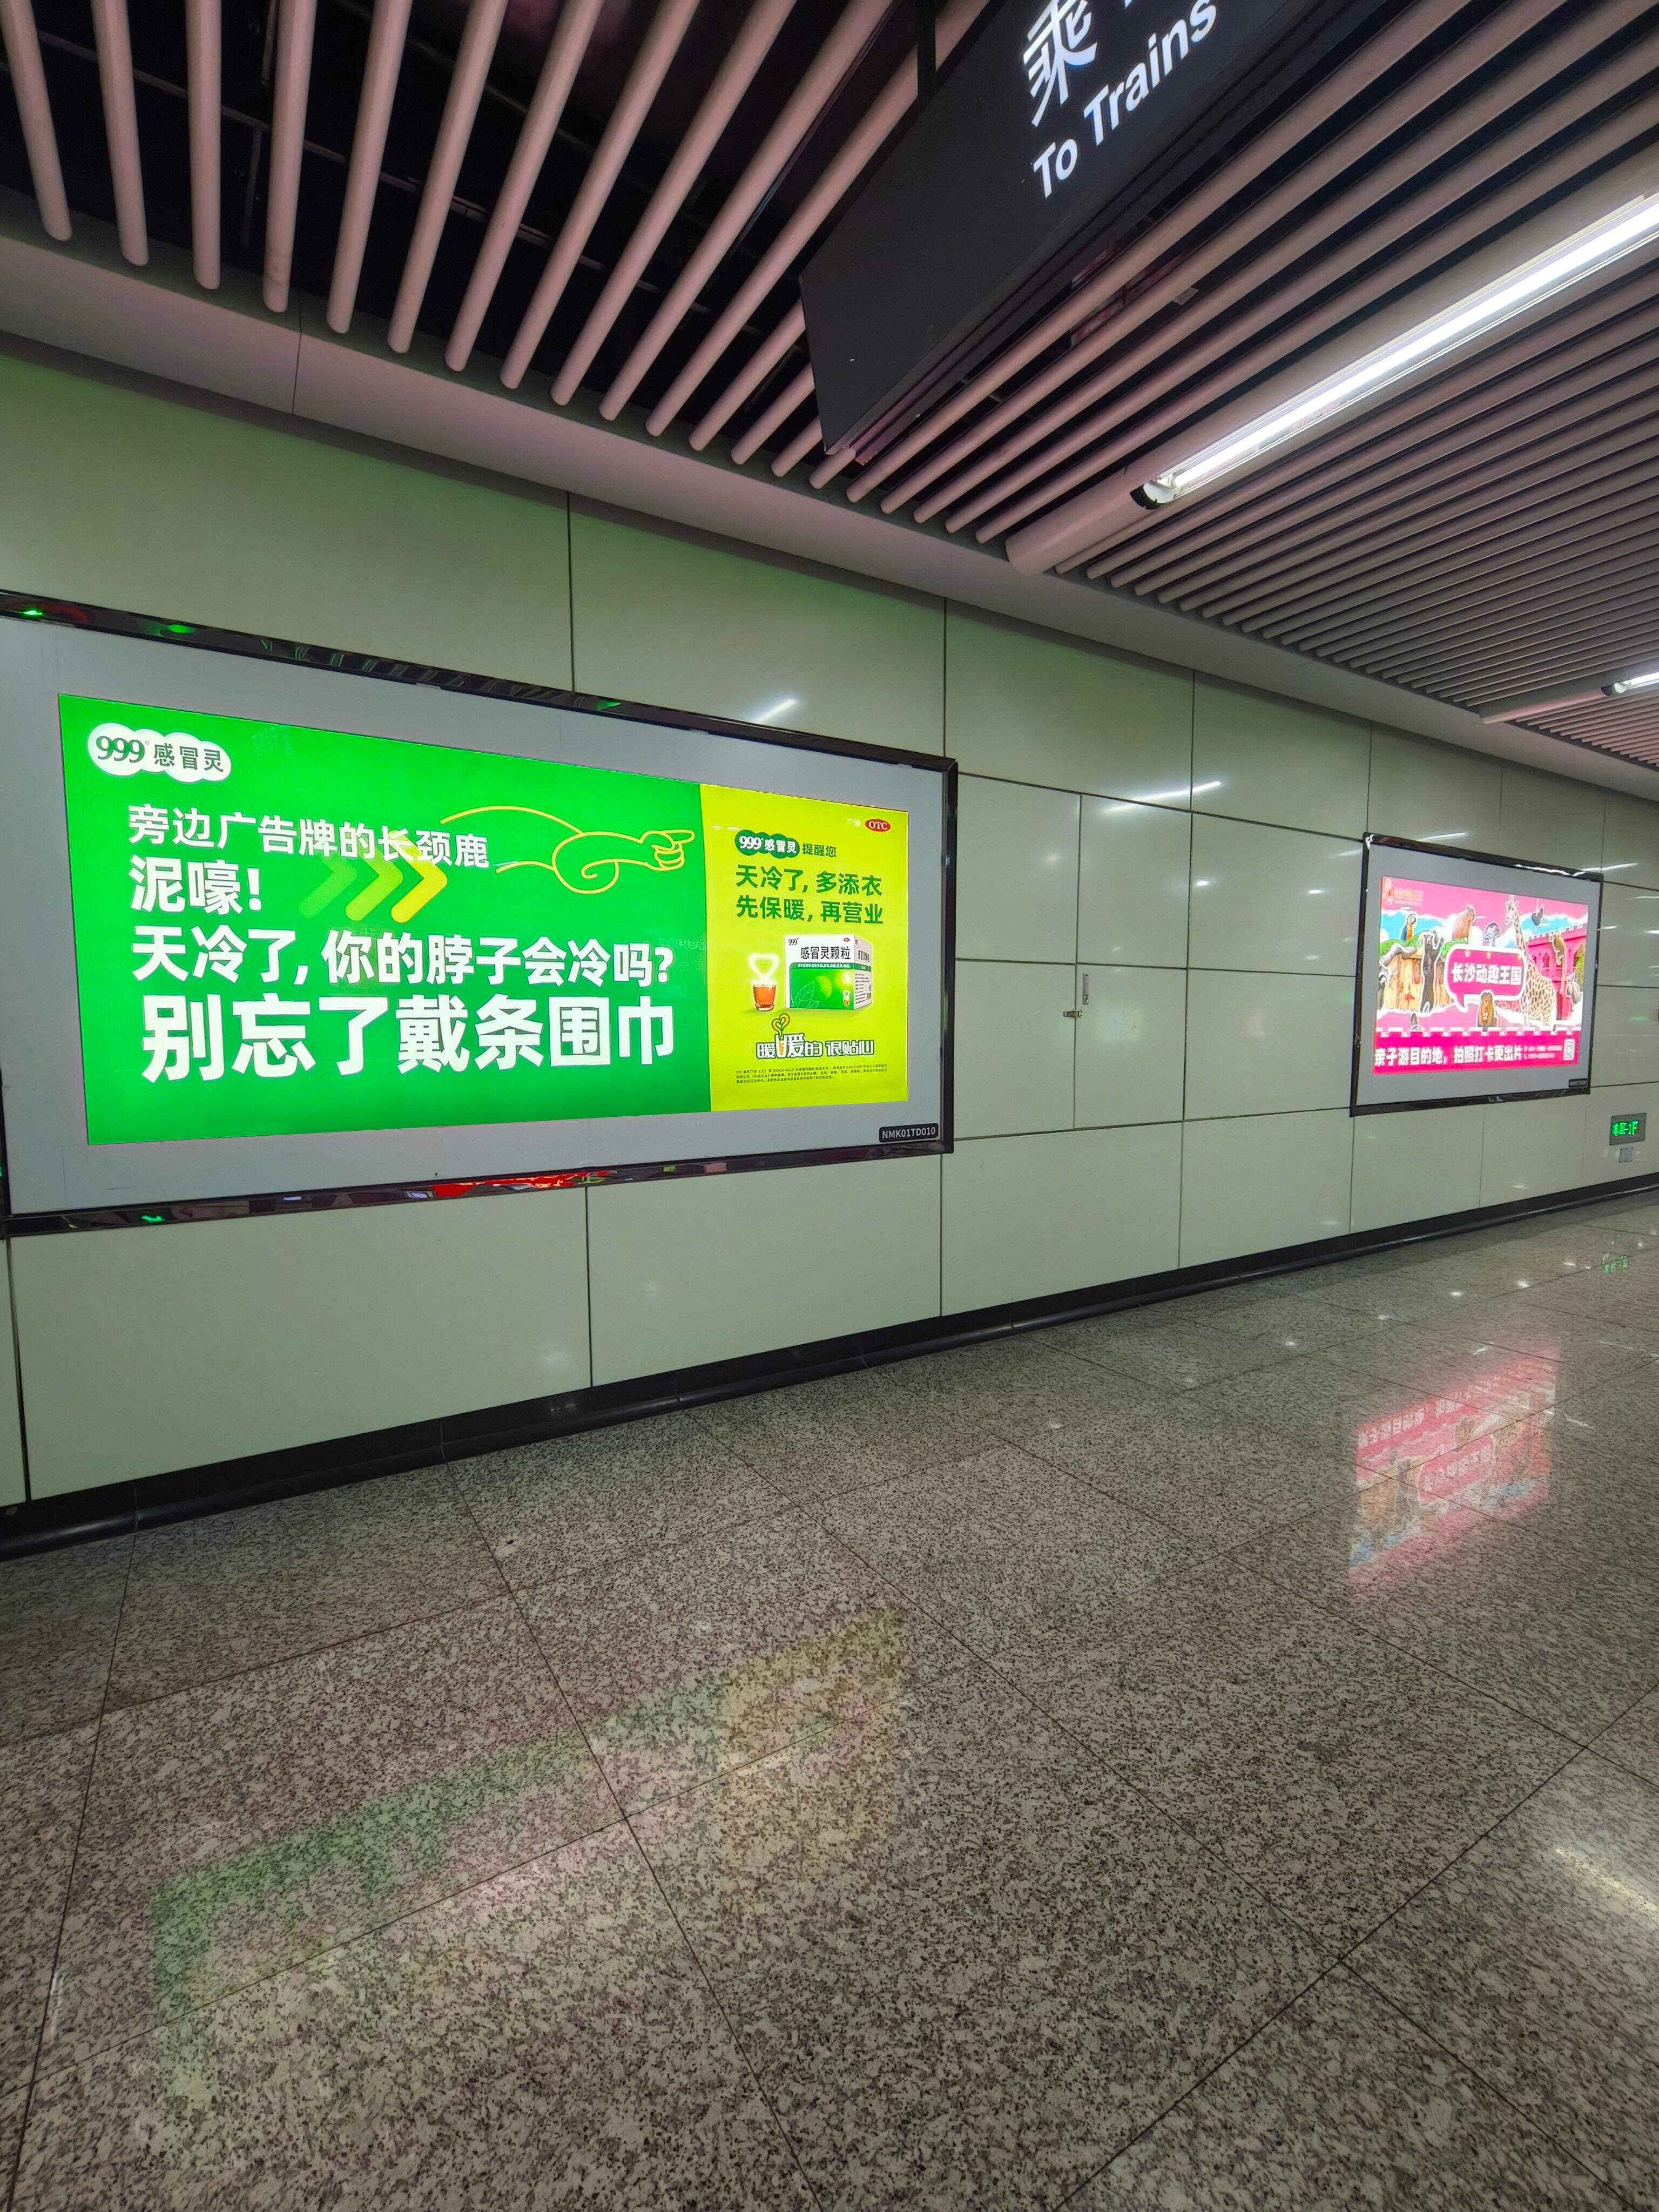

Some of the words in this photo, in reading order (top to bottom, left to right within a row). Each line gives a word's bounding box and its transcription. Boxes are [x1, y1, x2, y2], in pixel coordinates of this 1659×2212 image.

[1023, 0, 1135, 126] 乘
[1033, 139, 1077, 198] To
[1083, 0, 1217, 146] Trains
[153, 743, 224, 772] 感冒灵
[128, 804, 490, 868] 旁边广告牌的长颈鹿
[868, 821, 888, 831] OTC
[802, 842, 837, 858] 提醒您
[129, 854, 262, 915] 泥嚎！
[736, 864, 882, 896] 天冷了，多添衣
[736, 895, 884, 924] 先保暖，再营业
[800, 946, 851, 960] 感冒灵颗粒
[141, 992, 674, 1083] 别忘了戴条围巾
[882, 1127, 936, 1139] NMK01TD010
